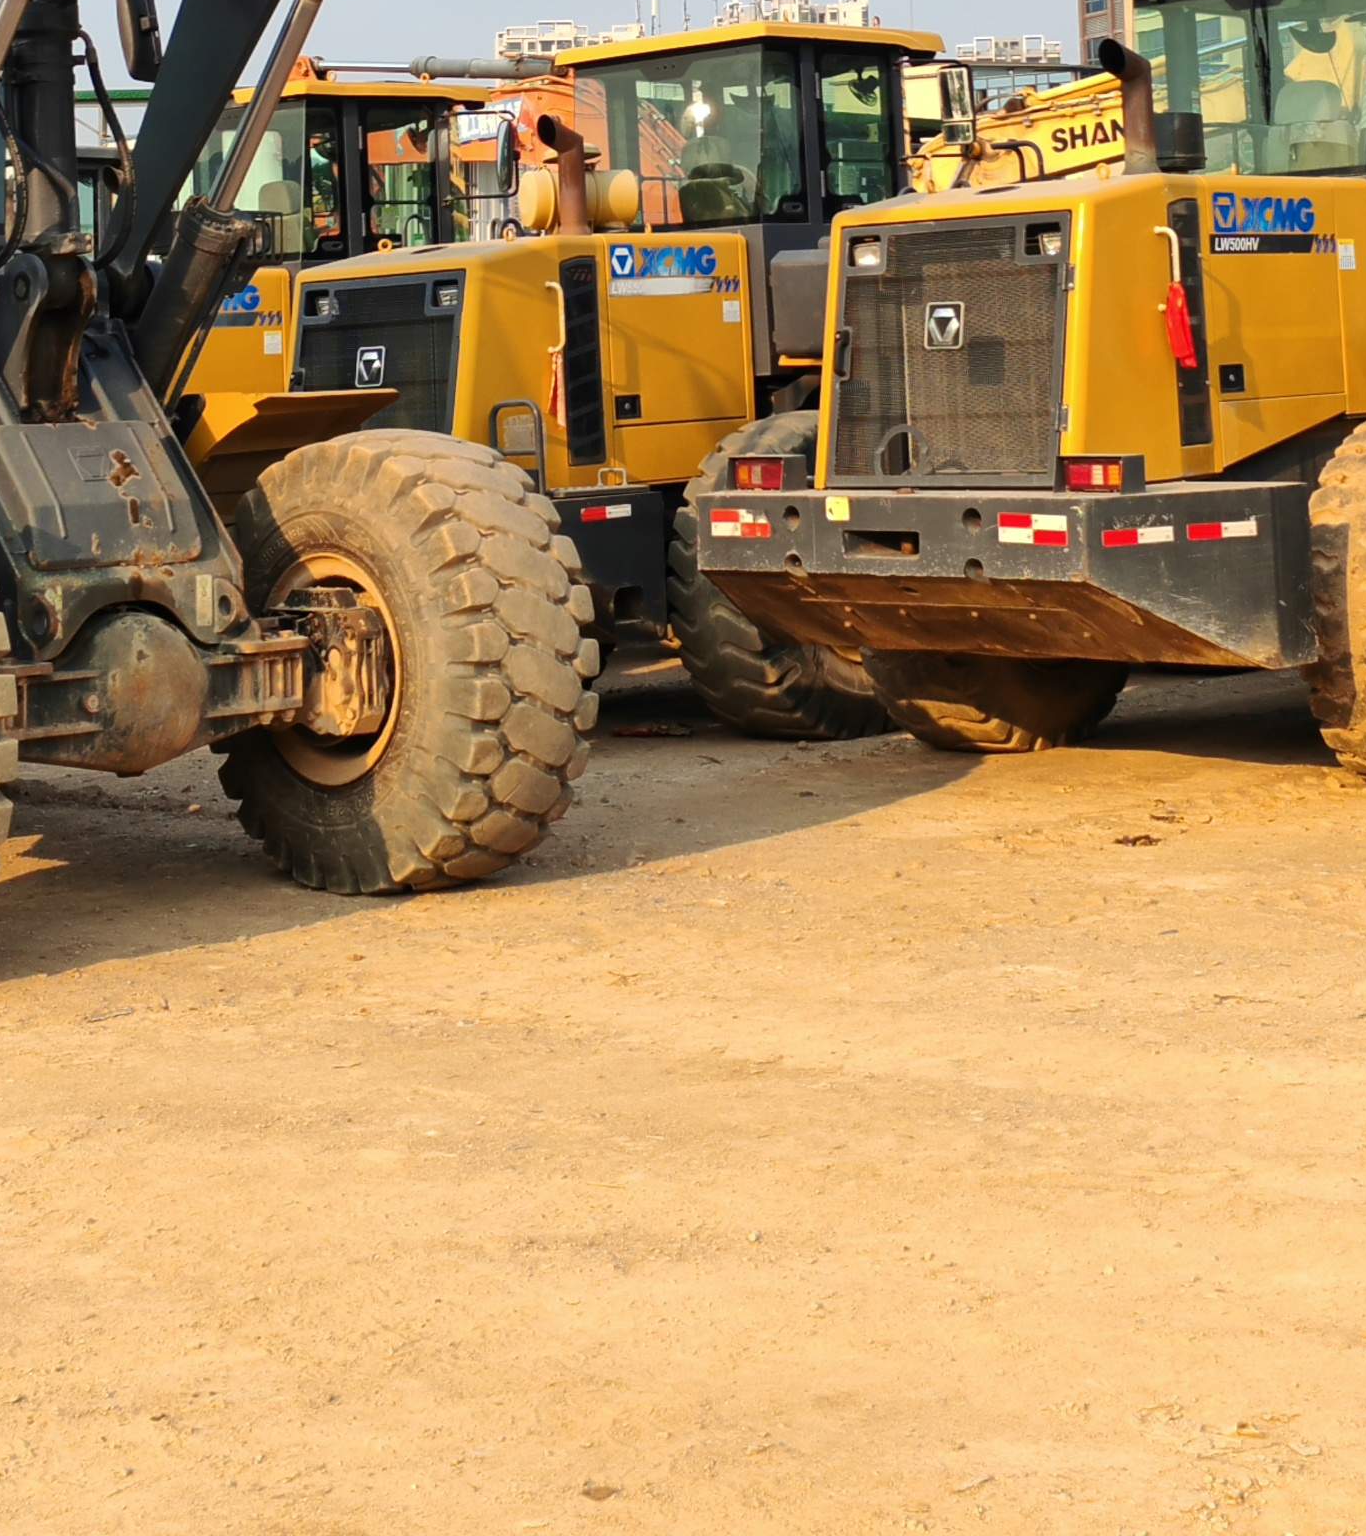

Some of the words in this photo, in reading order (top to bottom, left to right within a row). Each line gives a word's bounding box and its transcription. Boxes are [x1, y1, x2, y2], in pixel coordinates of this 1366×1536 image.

[1241, 197, 1315, 233] XCMG
[1214, 237, 1260, 252] LW500HV
[639, 245, 717, 277] XCMG
